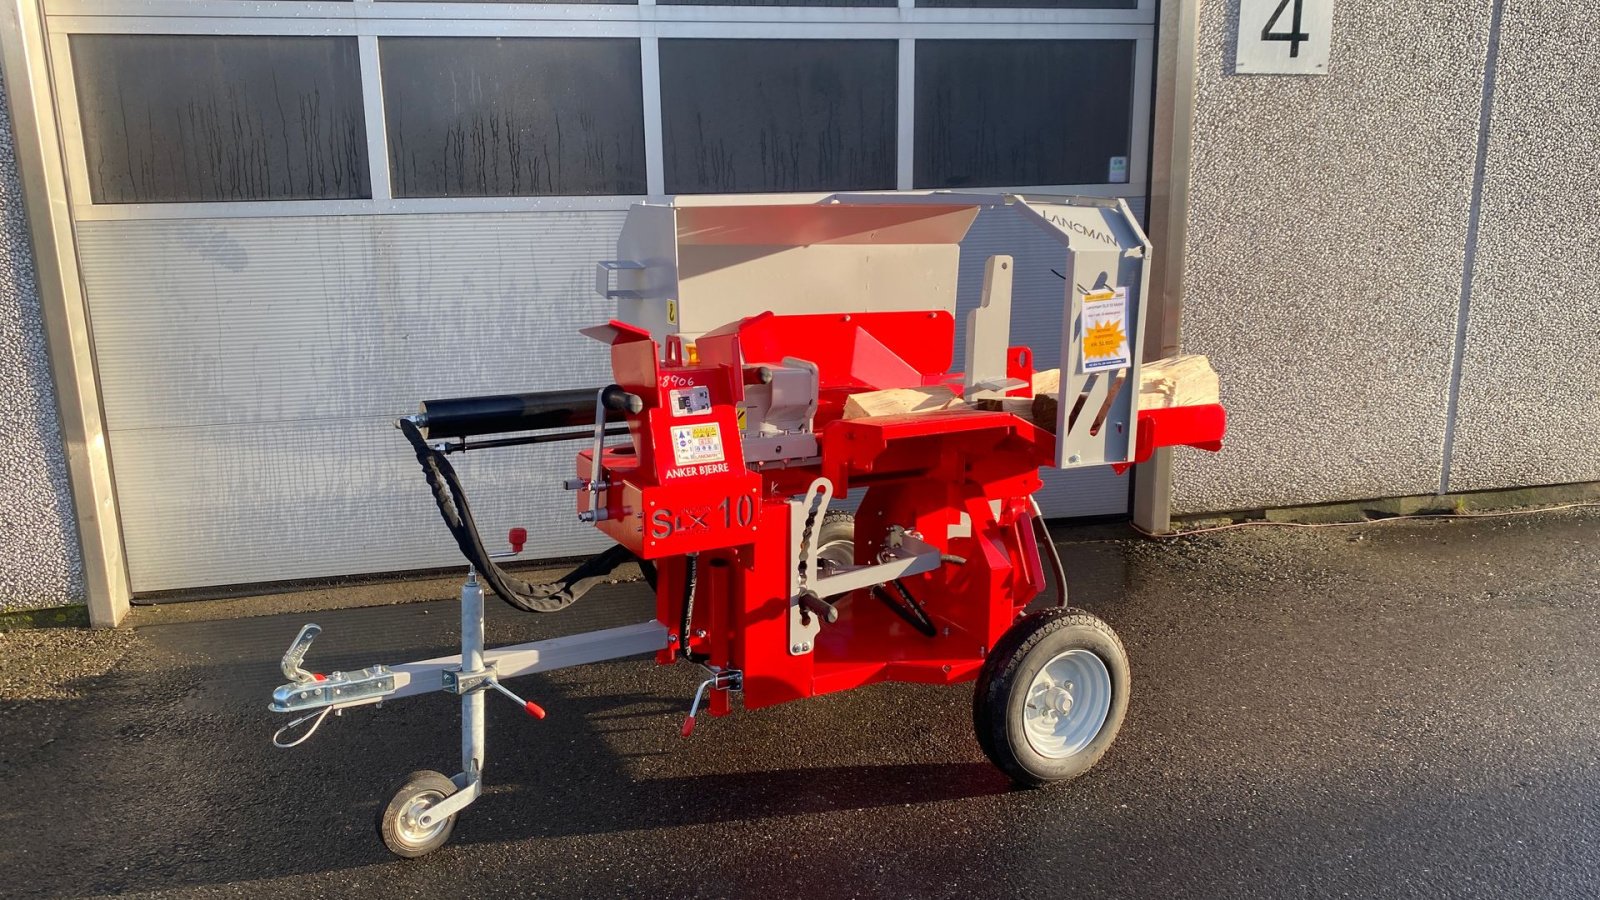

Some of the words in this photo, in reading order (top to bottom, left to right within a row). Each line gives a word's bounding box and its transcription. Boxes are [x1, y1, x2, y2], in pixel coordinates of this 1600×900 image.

[1261, 0, 1309, 58] 4
[1043, 210, 1117, 247] LANCMAN
[665, 466, 698, 479] ANKER
[700, 463, 729, 476] BJERRE
[718, 494, 753, 529] 10
